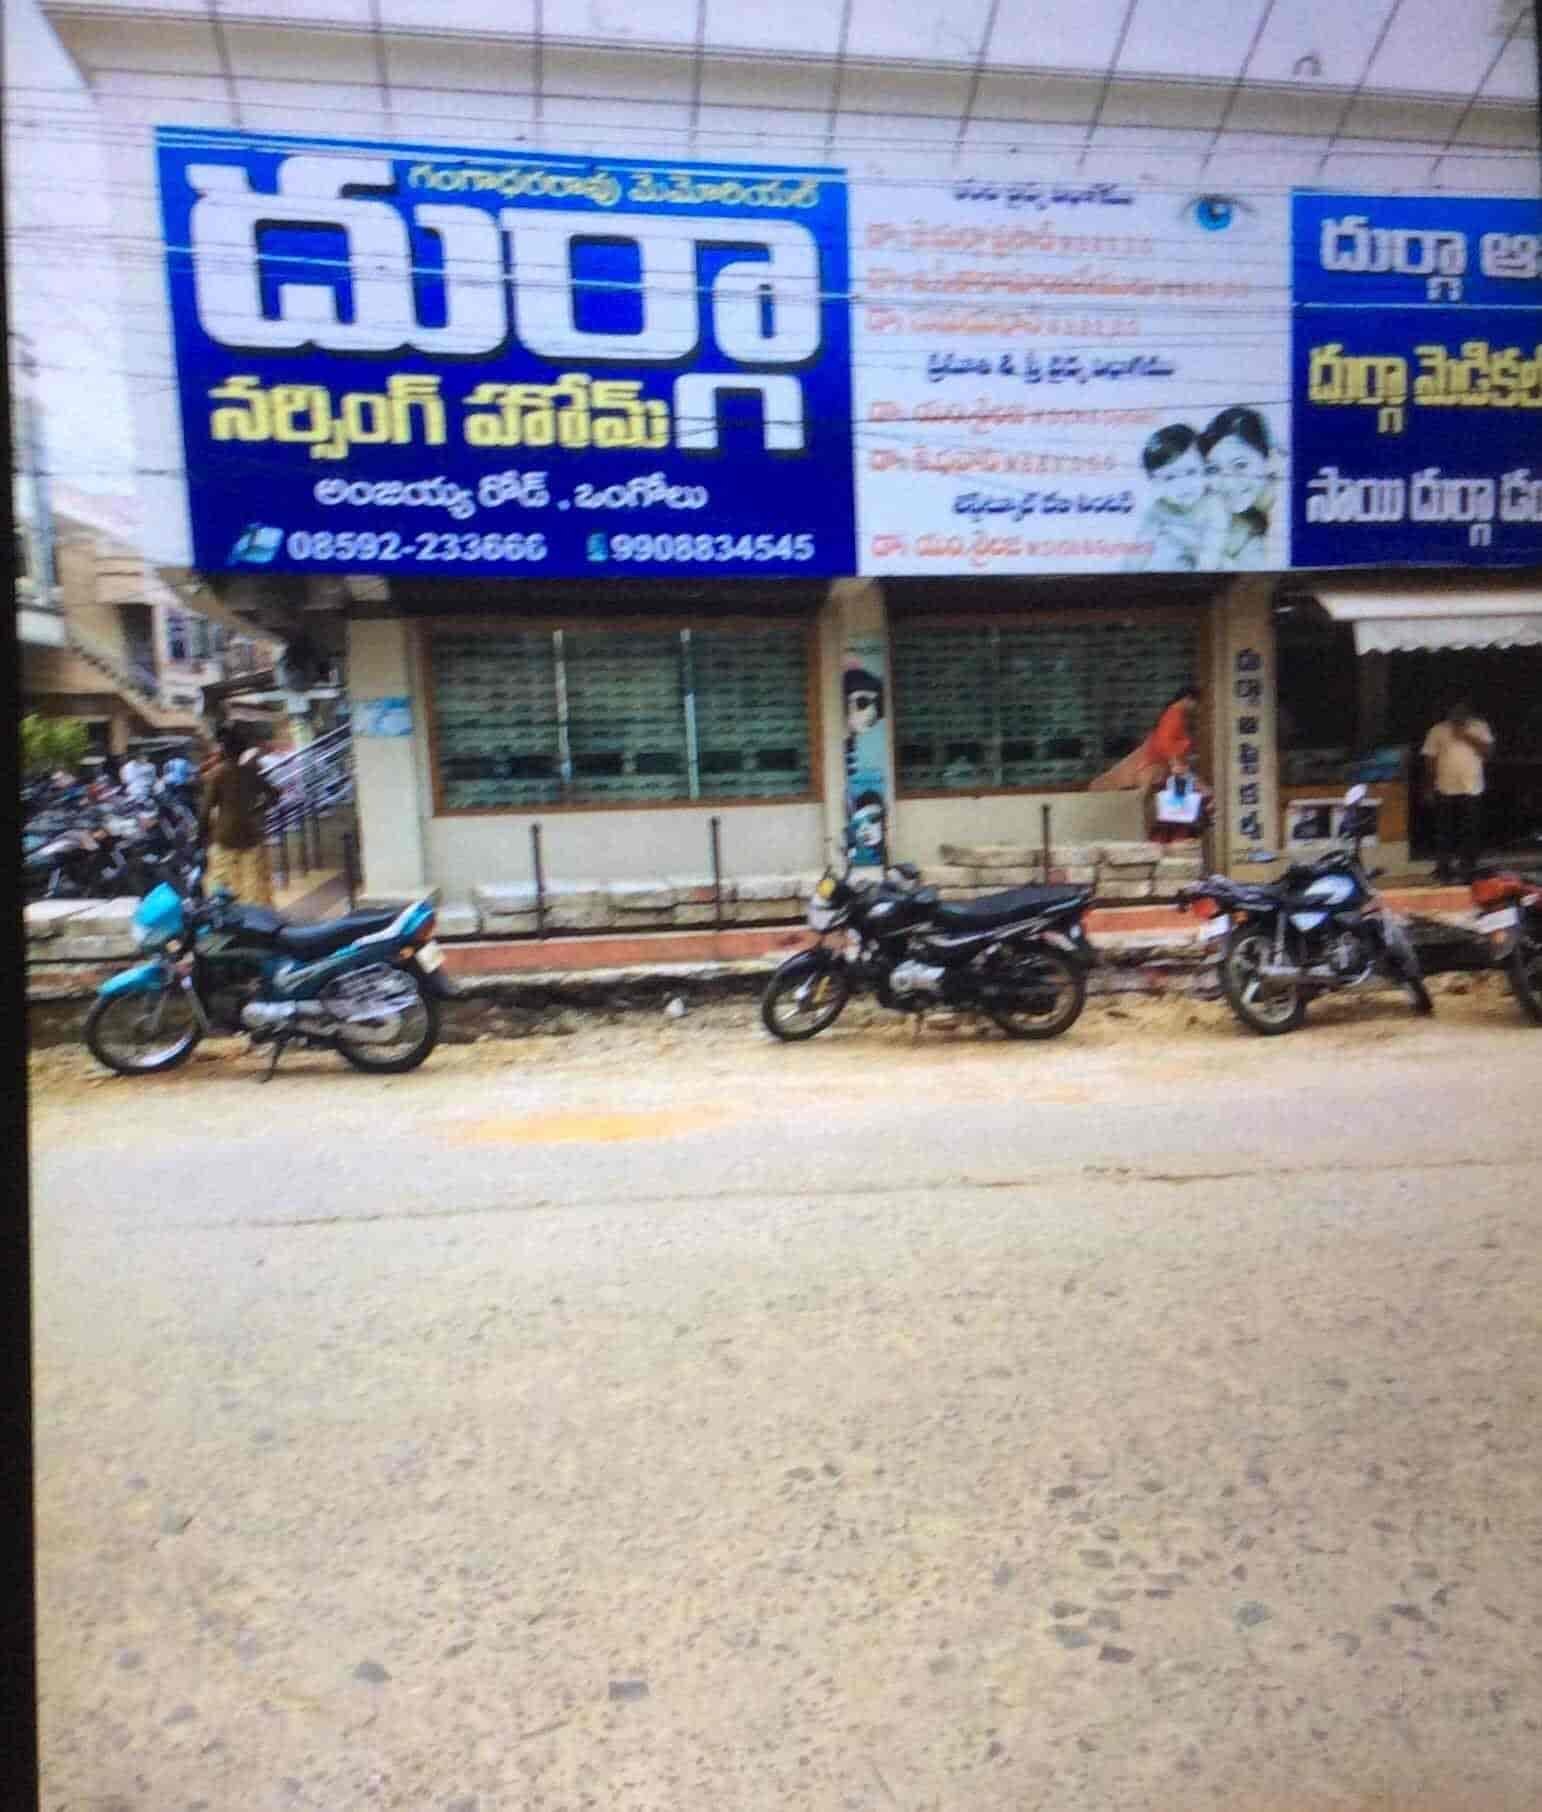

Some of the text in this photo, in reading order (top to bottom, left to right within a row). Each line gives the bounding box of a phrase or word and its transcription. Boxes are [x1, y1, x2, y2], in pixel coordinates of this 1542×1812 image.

[1320, 215, 1467, 301] దుర్గా
[186, 154, 822, 451] దుర్గా
[210, 372, 669, 459] నర్సింగ్ హోమ్
[1308, 343, 1407, 435] దుర్గా
[287, 530, 547, 562] 08592-233666
[610, 532, 815, 562] 9908834545
[1409, 467, 1495, 547] దుర్గా
